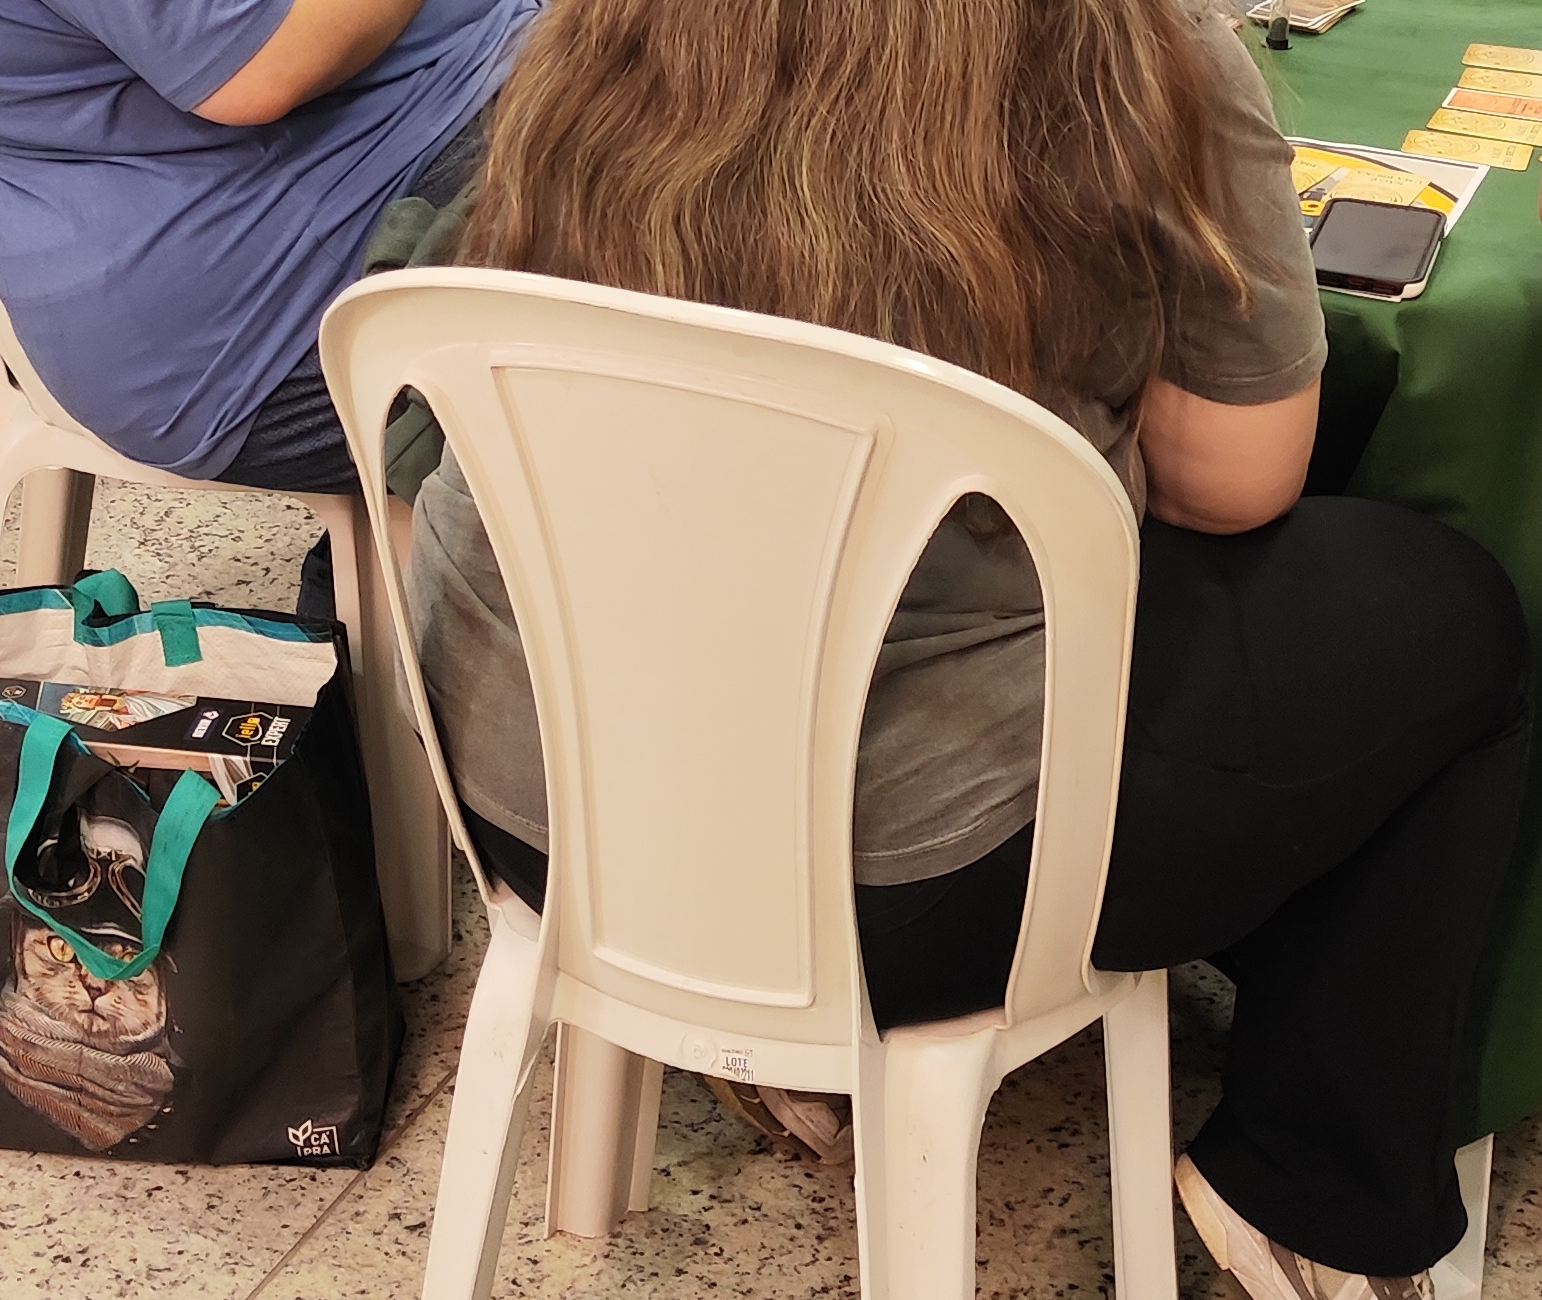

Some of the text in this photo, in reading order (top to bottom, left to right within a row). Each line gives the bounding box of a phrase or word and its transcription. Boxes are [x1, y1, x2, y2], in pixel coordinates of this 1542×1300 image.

[260, 715, 292, 747] EXPERT
[725, 1056, 749, 1068] LOTE
[310, 1130, 330, 1146] CÁ
[303, 1144, 332, 1157] PRA
